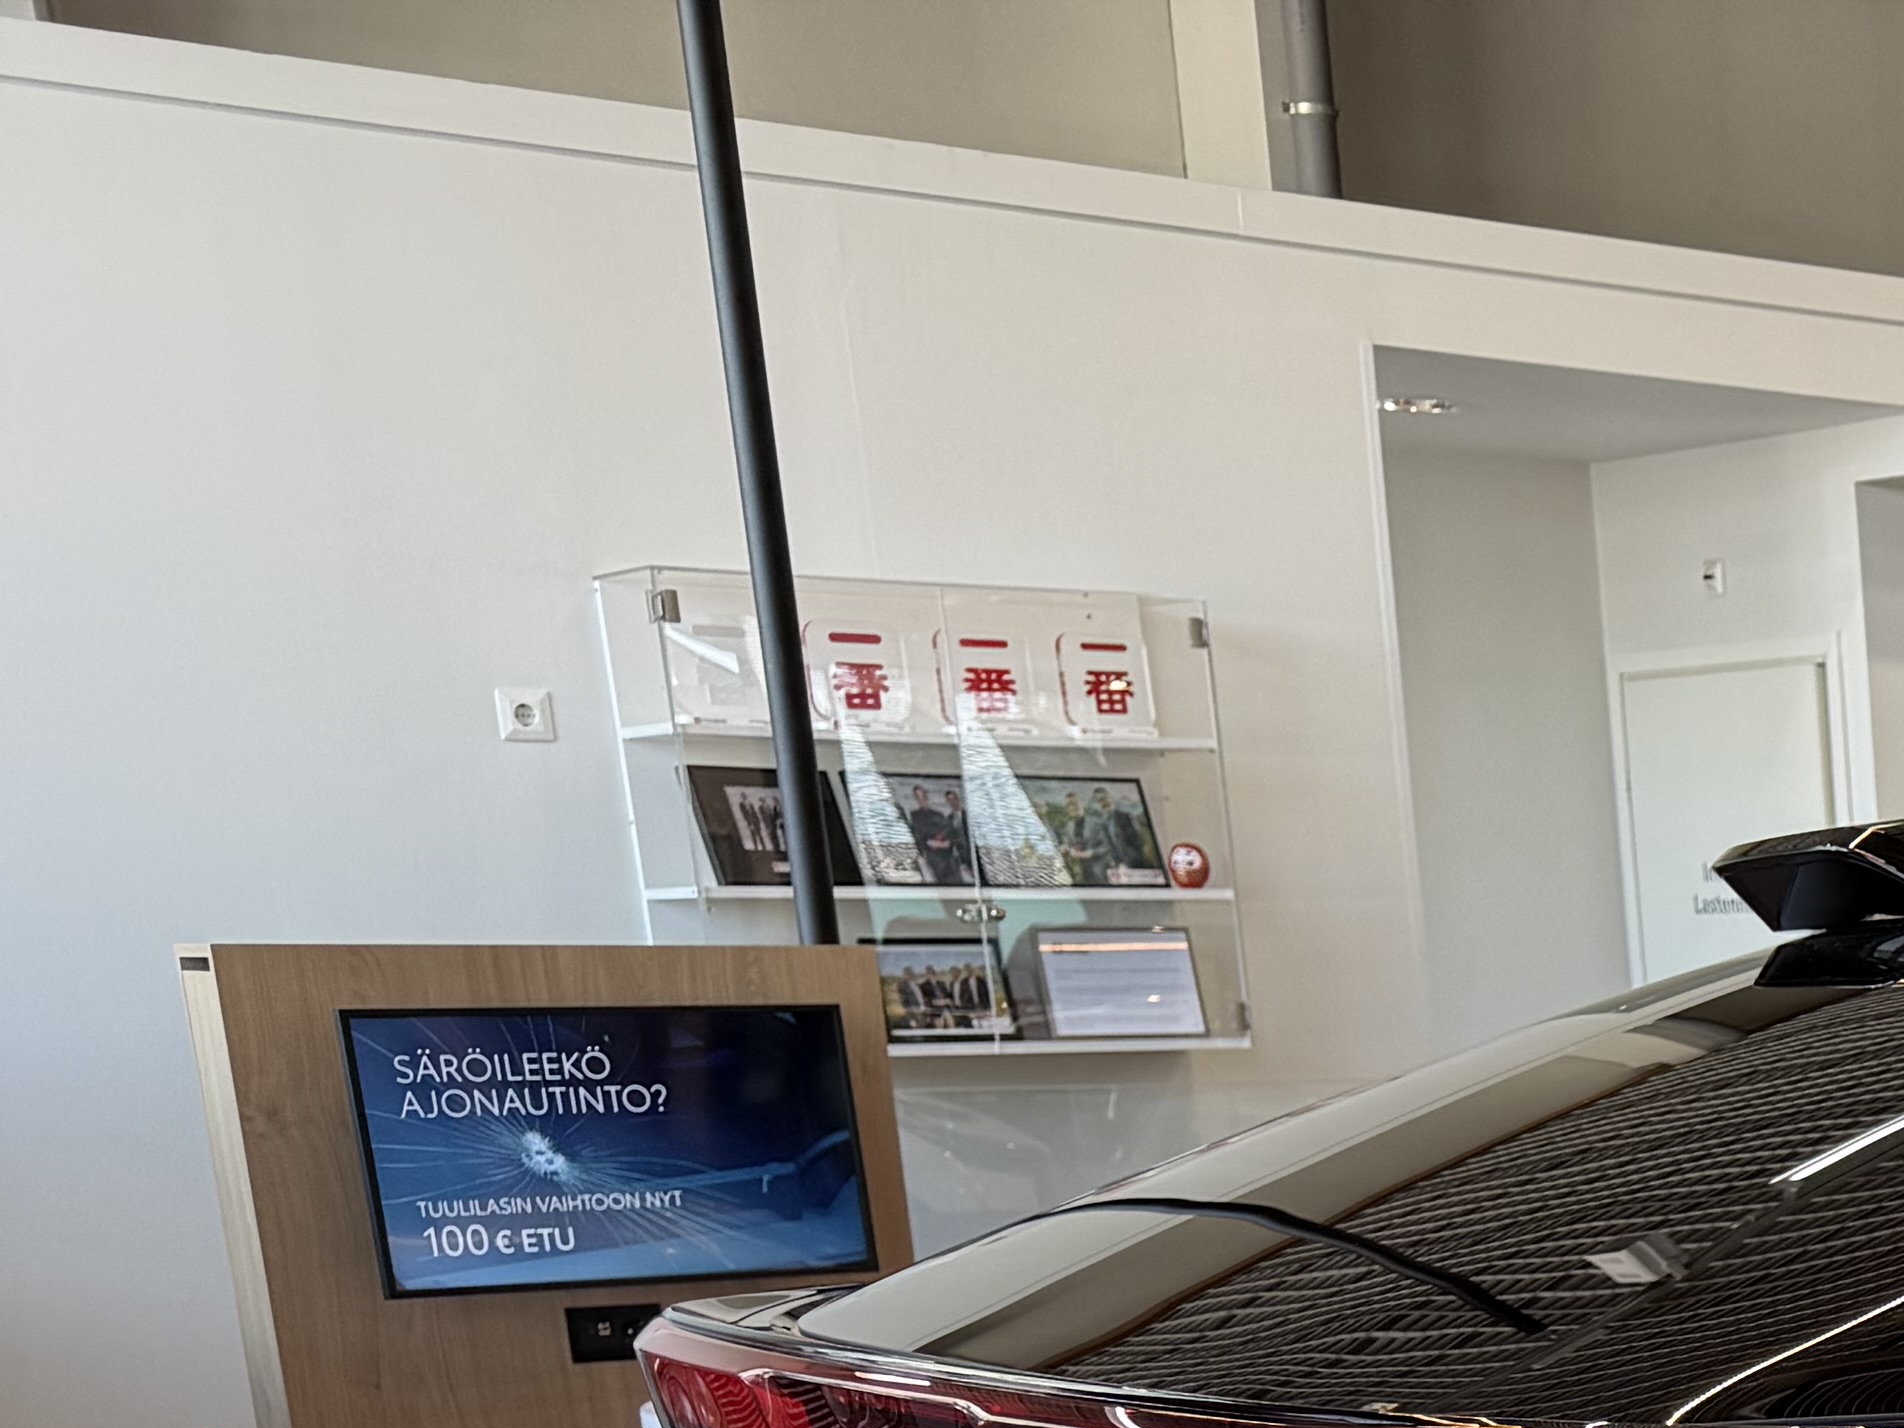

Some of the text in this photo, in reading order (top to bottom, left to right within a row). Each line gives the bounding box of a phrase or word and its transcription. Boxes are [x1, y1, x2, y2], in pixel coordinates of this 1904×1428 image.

[393, 1046, 611, 1084] SÄRÖILEEKÖ
[401, 1084, 667, 1119] AJONAUTINTO?
[416, 1190, 683, 1219] TUULILASIN VAIHTOON NYT
[422, 1224, 575, 1257] 100 € ETU
